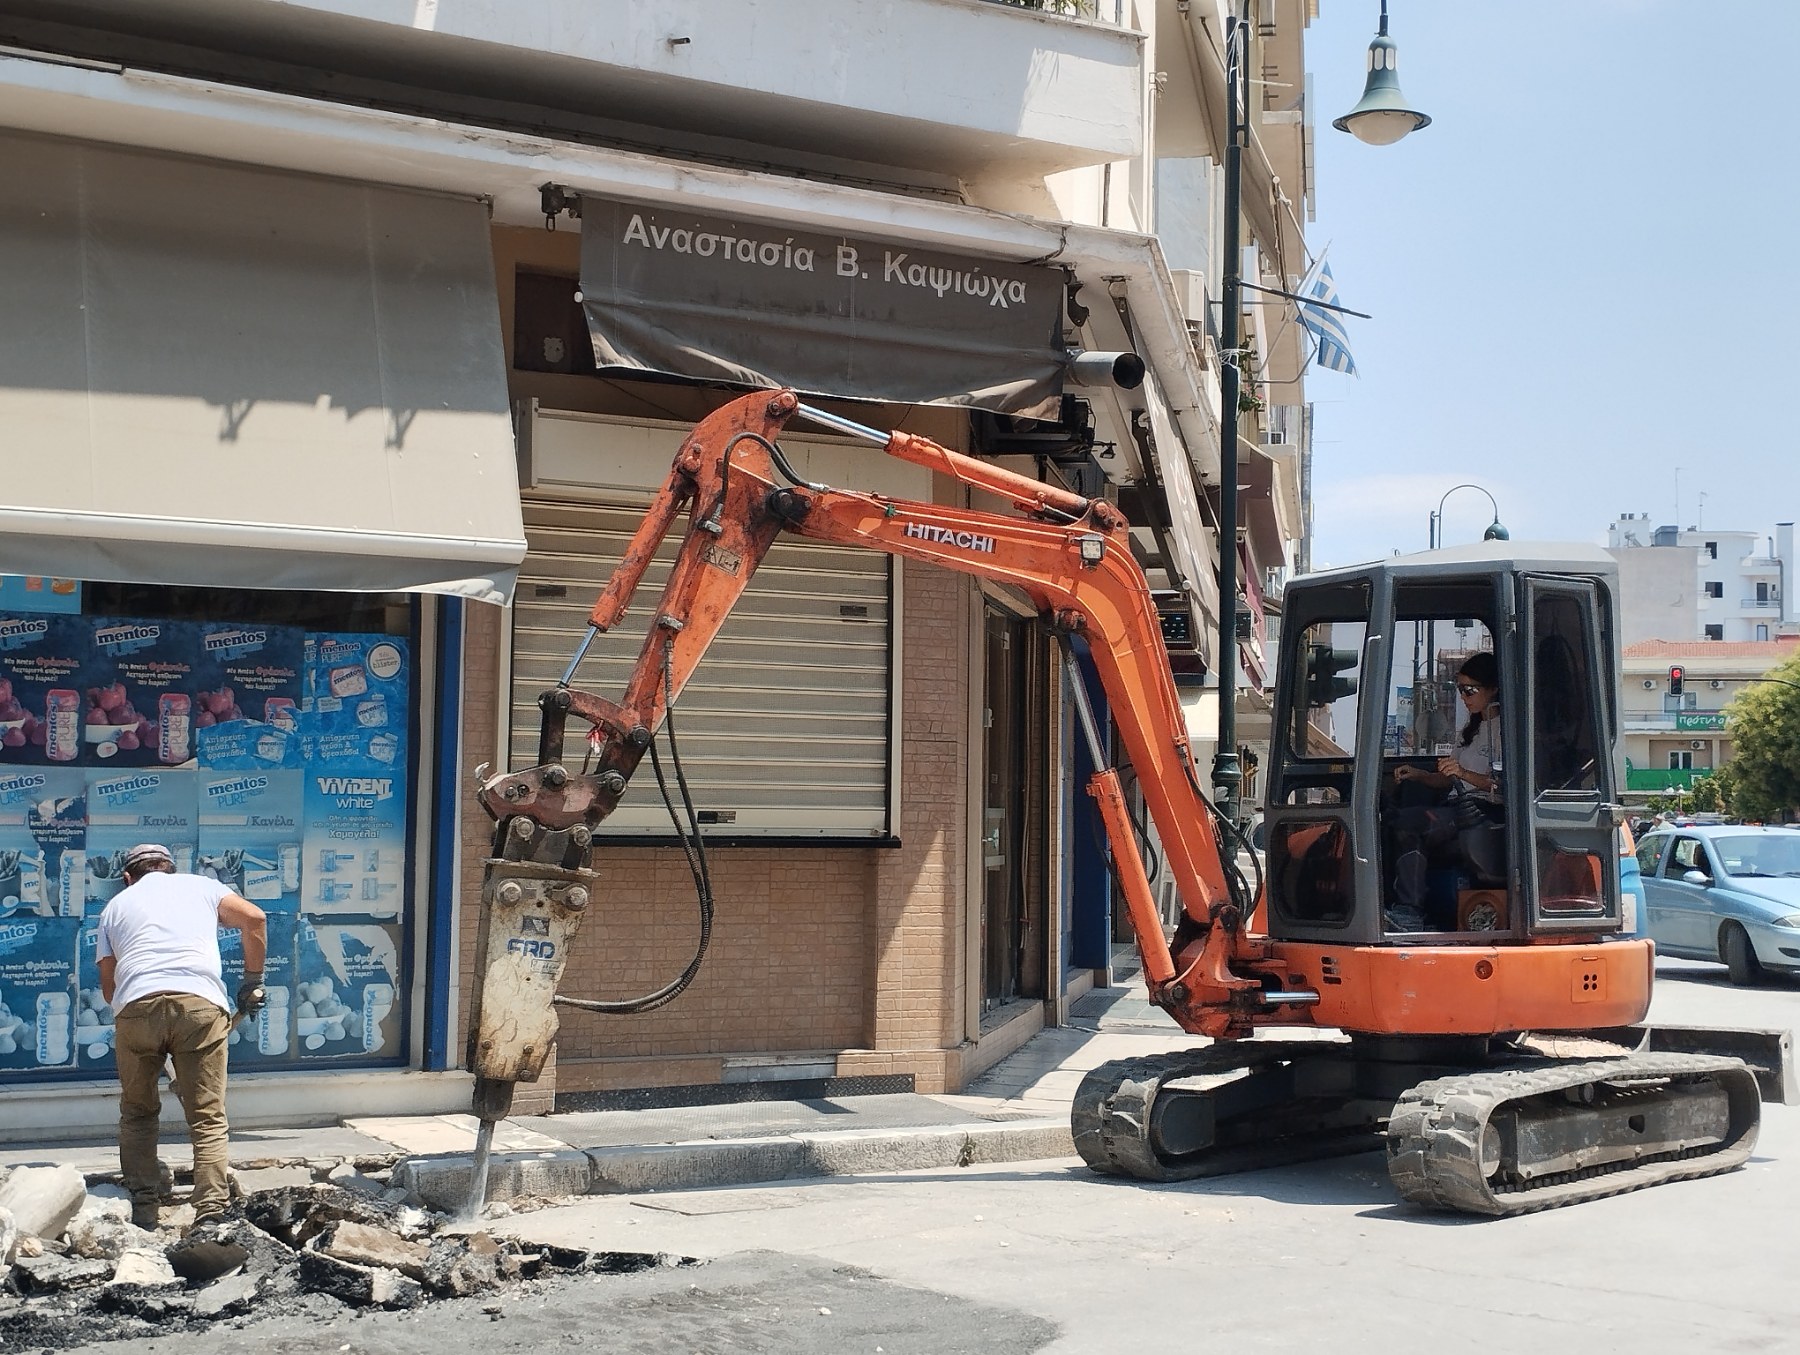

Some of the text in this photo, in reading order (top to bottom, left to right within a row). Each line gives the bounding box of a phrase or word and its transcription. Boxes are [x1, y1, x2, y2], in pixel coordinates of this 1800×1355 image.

[623, 214, 815, 272] Αναστασία
[884, 250, 1028, 309] Καψιώχα
[907, 522, 994, 553] HITACHI
[0, 621, 47, 636] entos
[98, 626, 160, 644] mentos
[207, 632, 266, 649] mentos
[321, 643, 361, 653] mentos
[334, 668, 362, 685] mentos
[50, 703, 58, 758] mentos
[162, 707, 170, 758] mentos
[0, 774, 45, 791] entos
[98, 775, 160, 795] mentos
[208, 776, 268, 796] mentos
[107, 791, 139, 808] PURE
[217, 792, 249, 808] PURE
[336, 796, 375, 808] white
[143, 815, 189, 828] Κανέλα
[251, 815, 295, 828] Κανέλα
[247, 875, 280, 885] mentos
[0, 923, 37, 941] ntos
[508, 938, 556, 959] FRD
[40, 1008, 48, 1060] mentos
